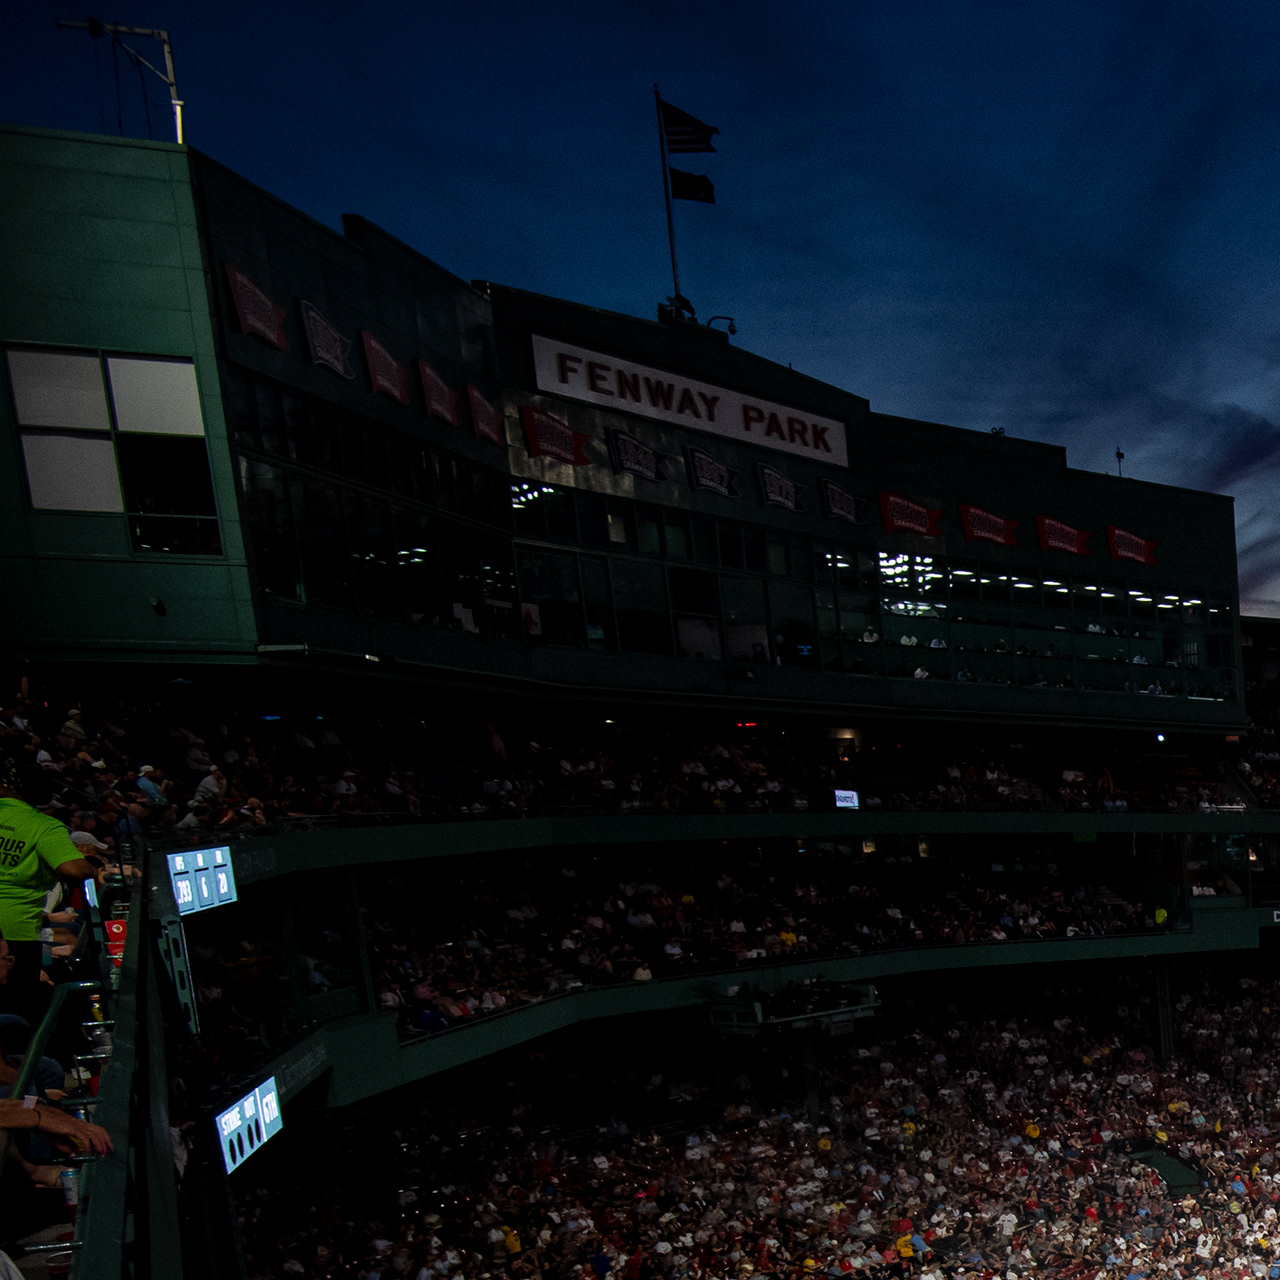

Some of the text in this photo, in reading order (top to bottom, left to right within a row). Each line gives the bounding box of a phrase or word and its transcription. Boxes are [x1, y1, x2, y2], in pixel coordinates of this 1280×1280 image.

[557, 353, 720, 421] FENWAY
[743, 404, 832, 453] PARK
[262, 1090, 278, 1124] 6TH
